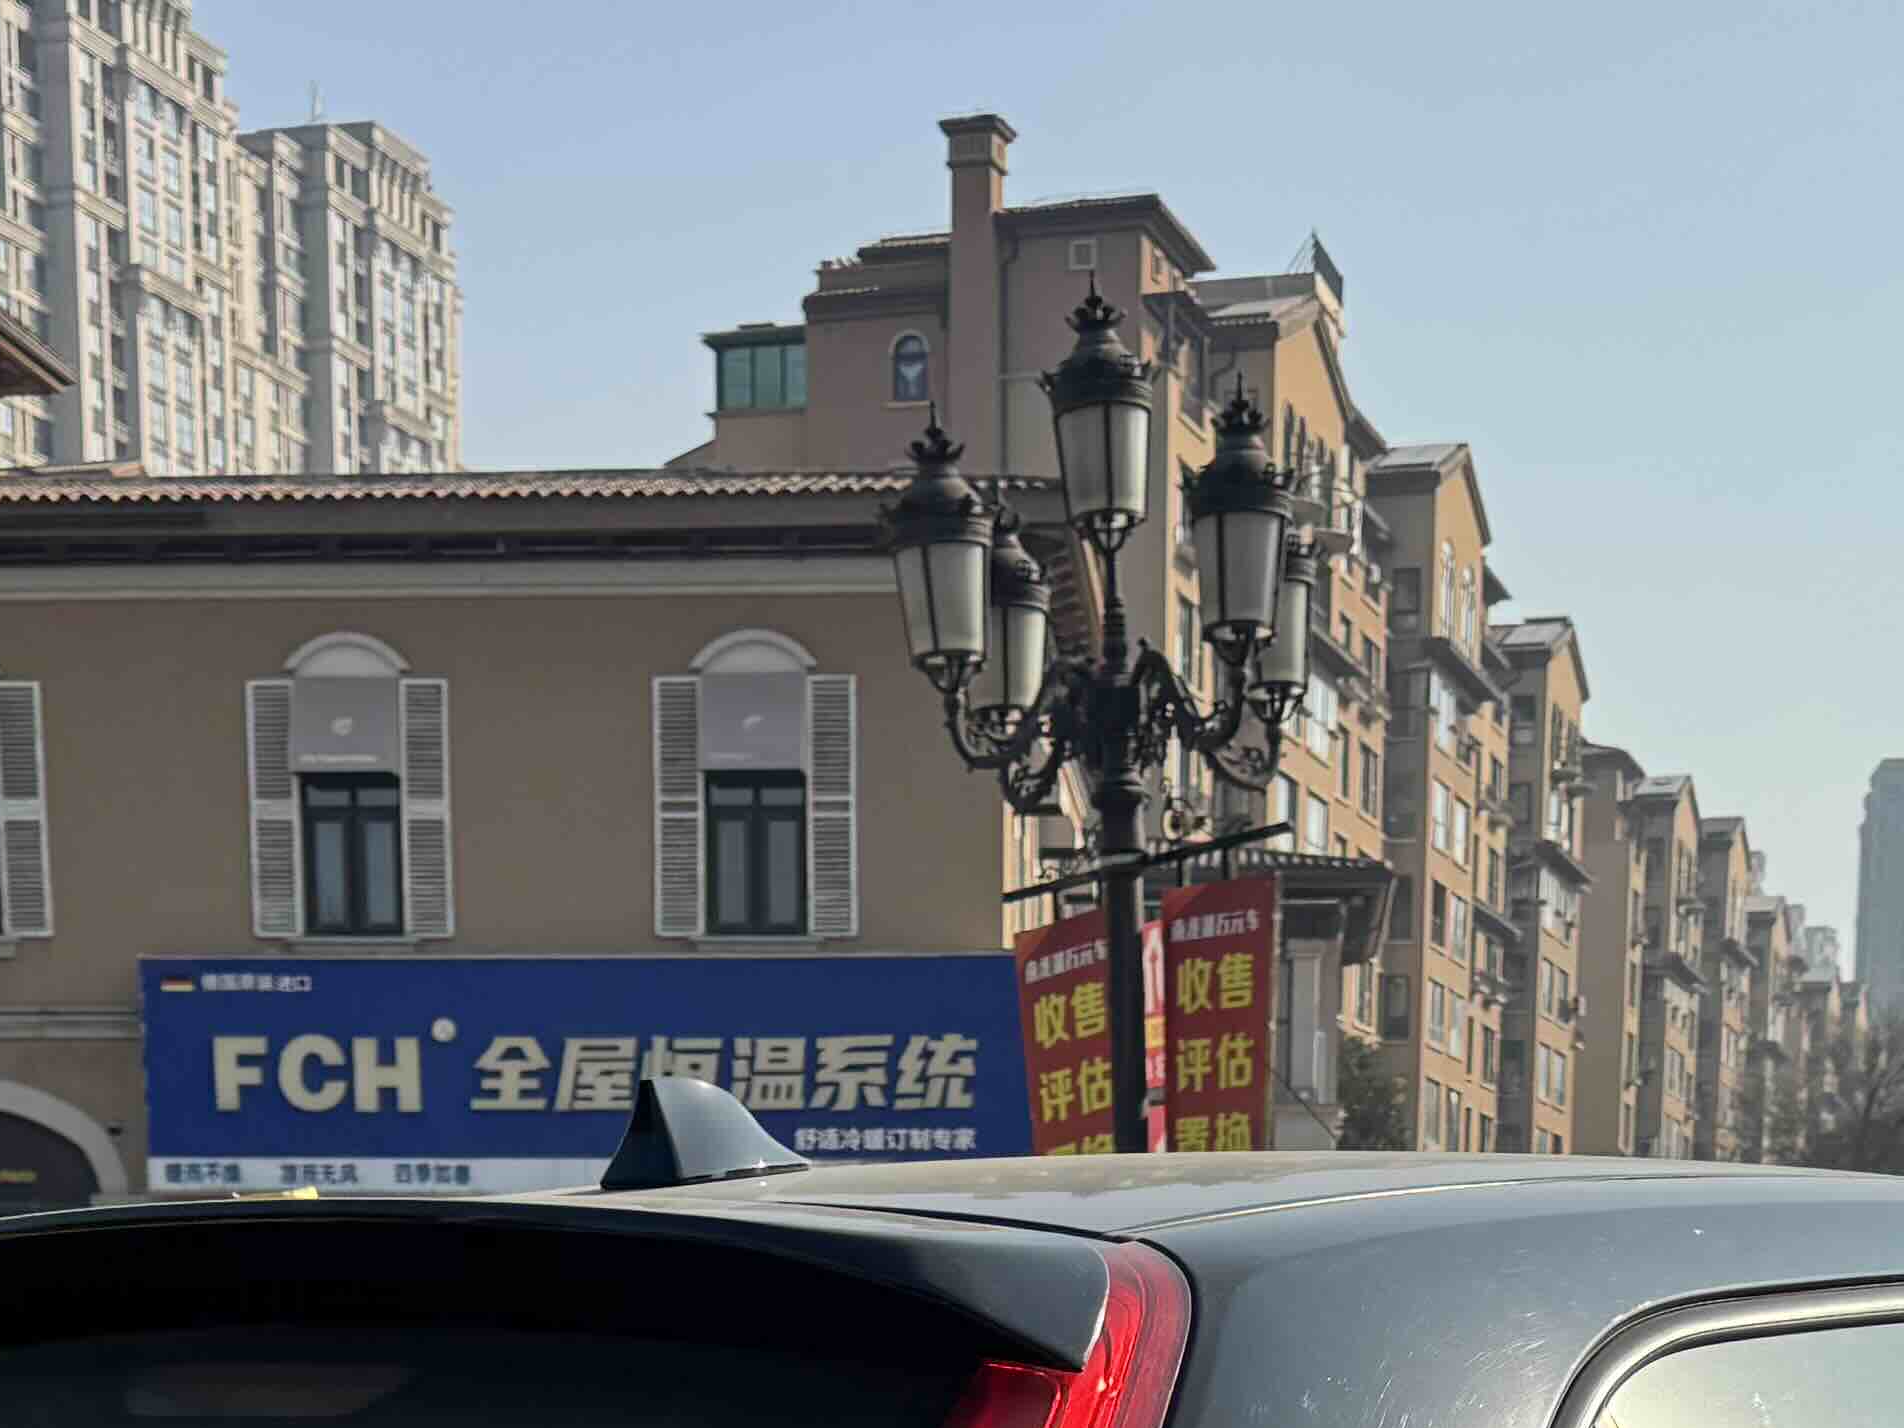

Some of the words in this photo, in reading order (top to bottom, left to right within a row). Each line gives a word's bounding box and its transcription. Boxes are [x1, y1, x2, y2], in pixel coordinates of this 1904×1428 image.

[1033, 981, 1106, 1048] 收售
[1176, 952, 1255, 1015] 收售
[212, 1033, 423, 1113] FCH
[470, 1033, 978, 1112] 全屋恒温系统
[1039, 1056, 1113, 1122] 评估
[1176, 1031, 1255, 1092] 评估
